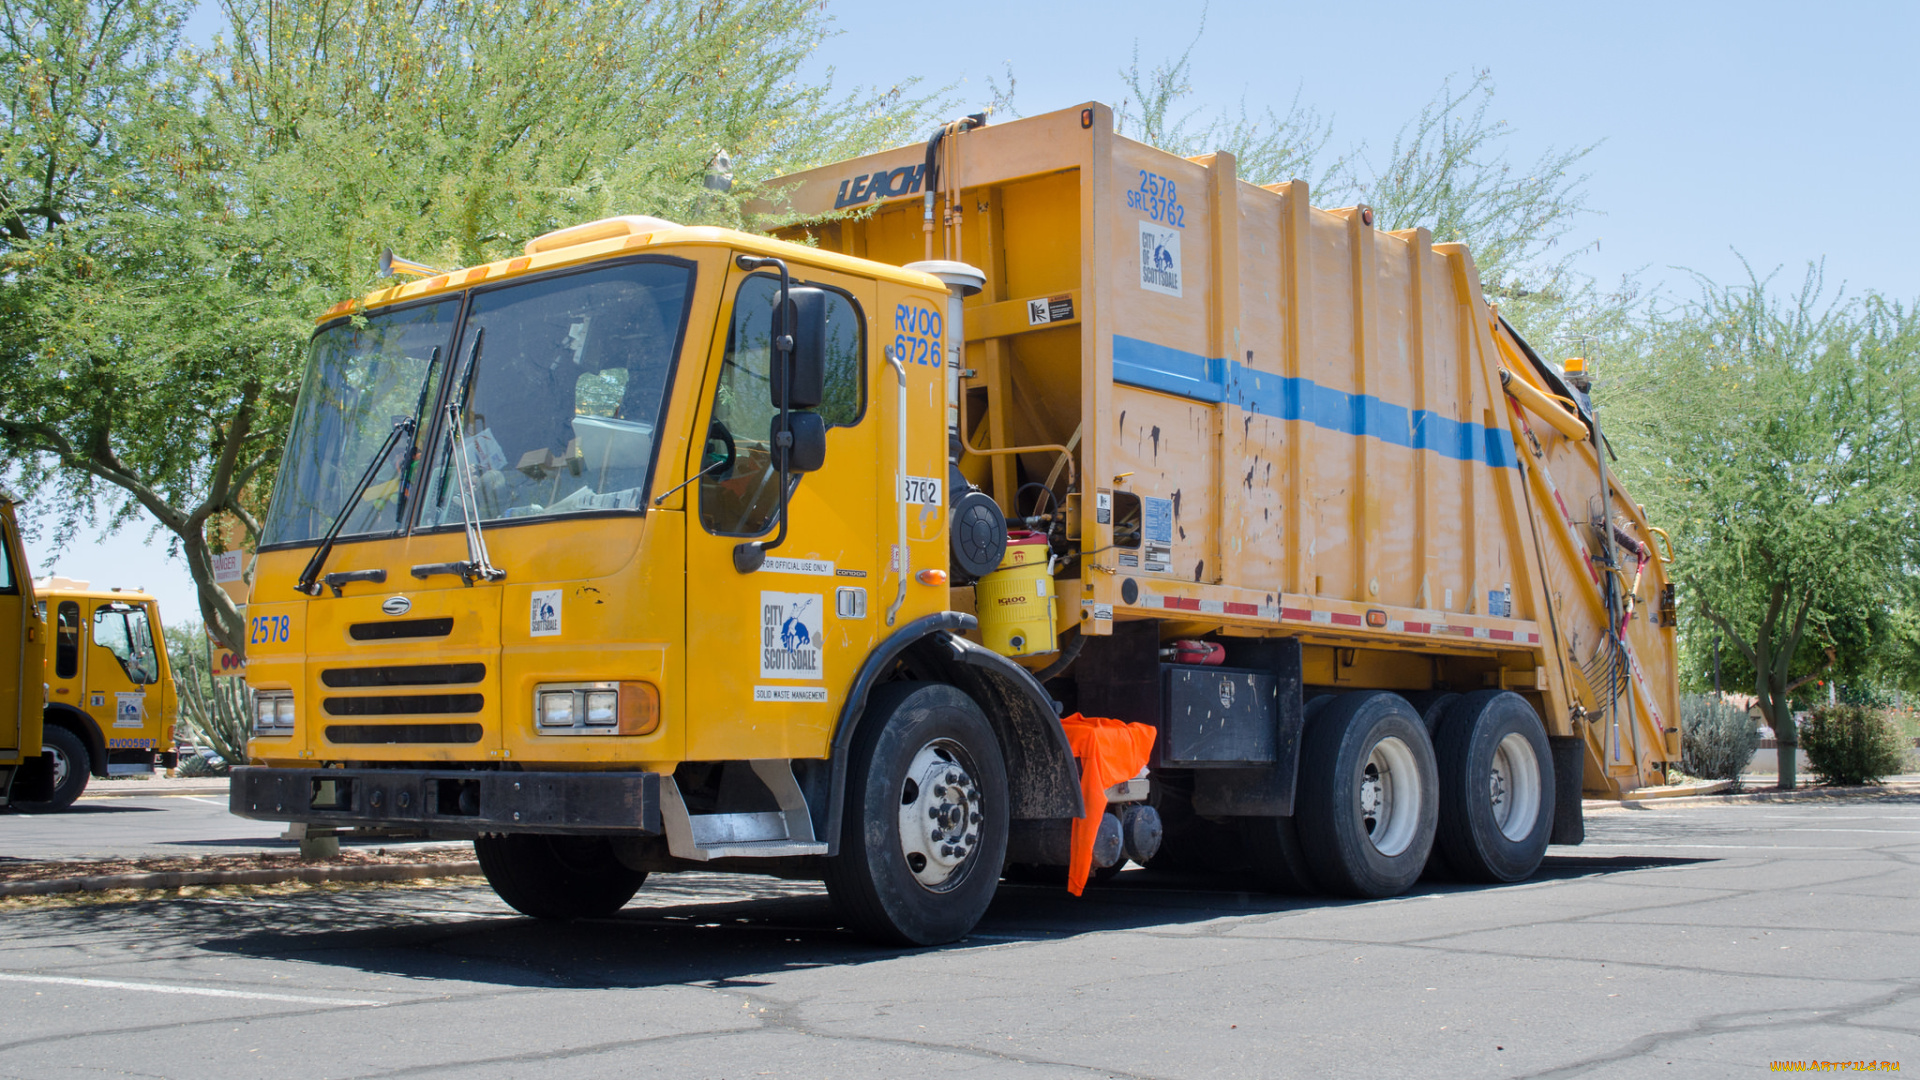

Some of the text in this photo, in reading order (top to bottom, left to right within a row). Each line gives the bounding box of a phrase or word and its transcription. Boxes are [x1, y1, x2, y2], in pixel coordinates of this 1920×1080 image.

[834, 163, 927, 209] LEACH
[1139, 169, 1177, 204] 2578
[1127, 189, 1186, 228] SRL 3762
[1142, 232, 1155, 250] CITY
[1142, 249, 1150, 266] OF
[1142, 266, 1178, 290] SCOTTSDALE
[895, 333, 942, 369] 6726
[762, 560, 828, 573] FOR OFFICIAL USE ONLY
[532, 598, 542, 609] CITY
[998, 596, 1026, 606] IGLOO
[532, 619, 557, 631] SCOTTSDALE
[764, 604, 784, 626] CITY
[251, 614, 290, 645] 2578
[764, 626, 775, 648] OF
[764, 648, 816, 671] SCOTTSDALE
[756, 689, 826, 700] SOLID WASTE MANAGEMENT
